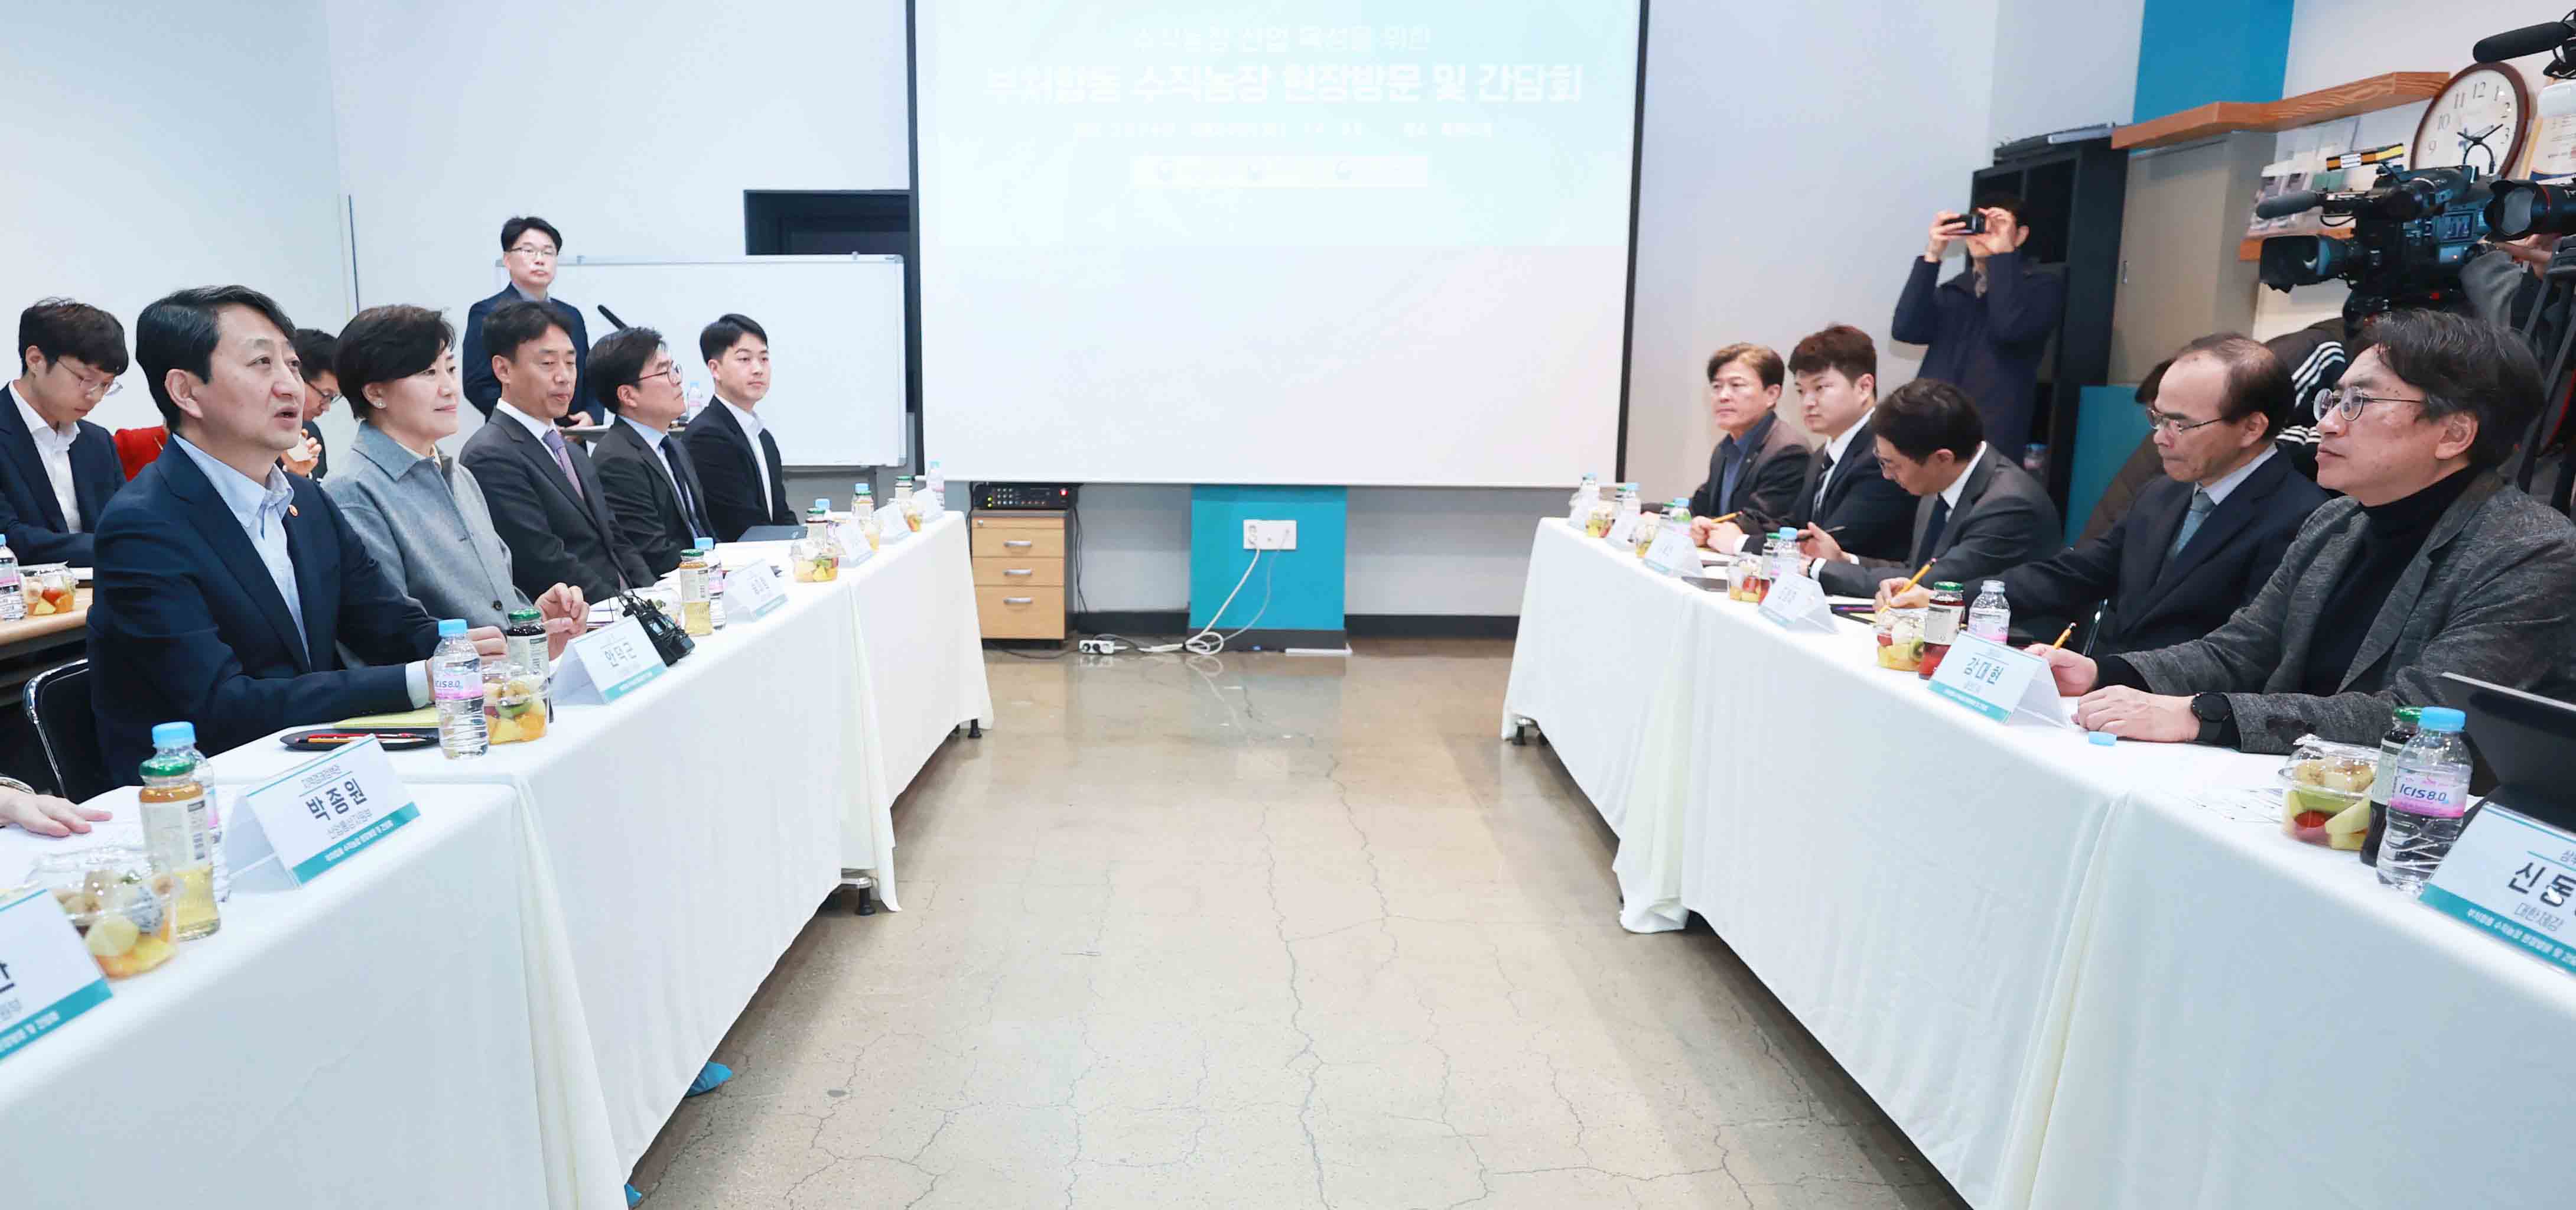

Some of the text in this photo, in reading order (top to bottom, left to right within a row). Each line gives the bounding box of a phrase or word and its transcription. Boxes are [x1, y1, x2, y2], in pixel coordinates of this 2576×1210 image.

[982, 63, 1583, 105] 부처합동 수직농장 현장방문 및 간담회
[2472, 81, 2486, 100] 12
[2453, 92, 2465, 109] 11
[2493, 85, 2500, 102] 1
[2500, 101, 2511, 119] 2
[2437, 113, 2451, 130] 10
[2500, 128, 2510, 145] 3
[2428, 140, 2437, 154] 9
[305, 778, 367, 821] 박종원
[2508, 862, 2576, 917] 신동
